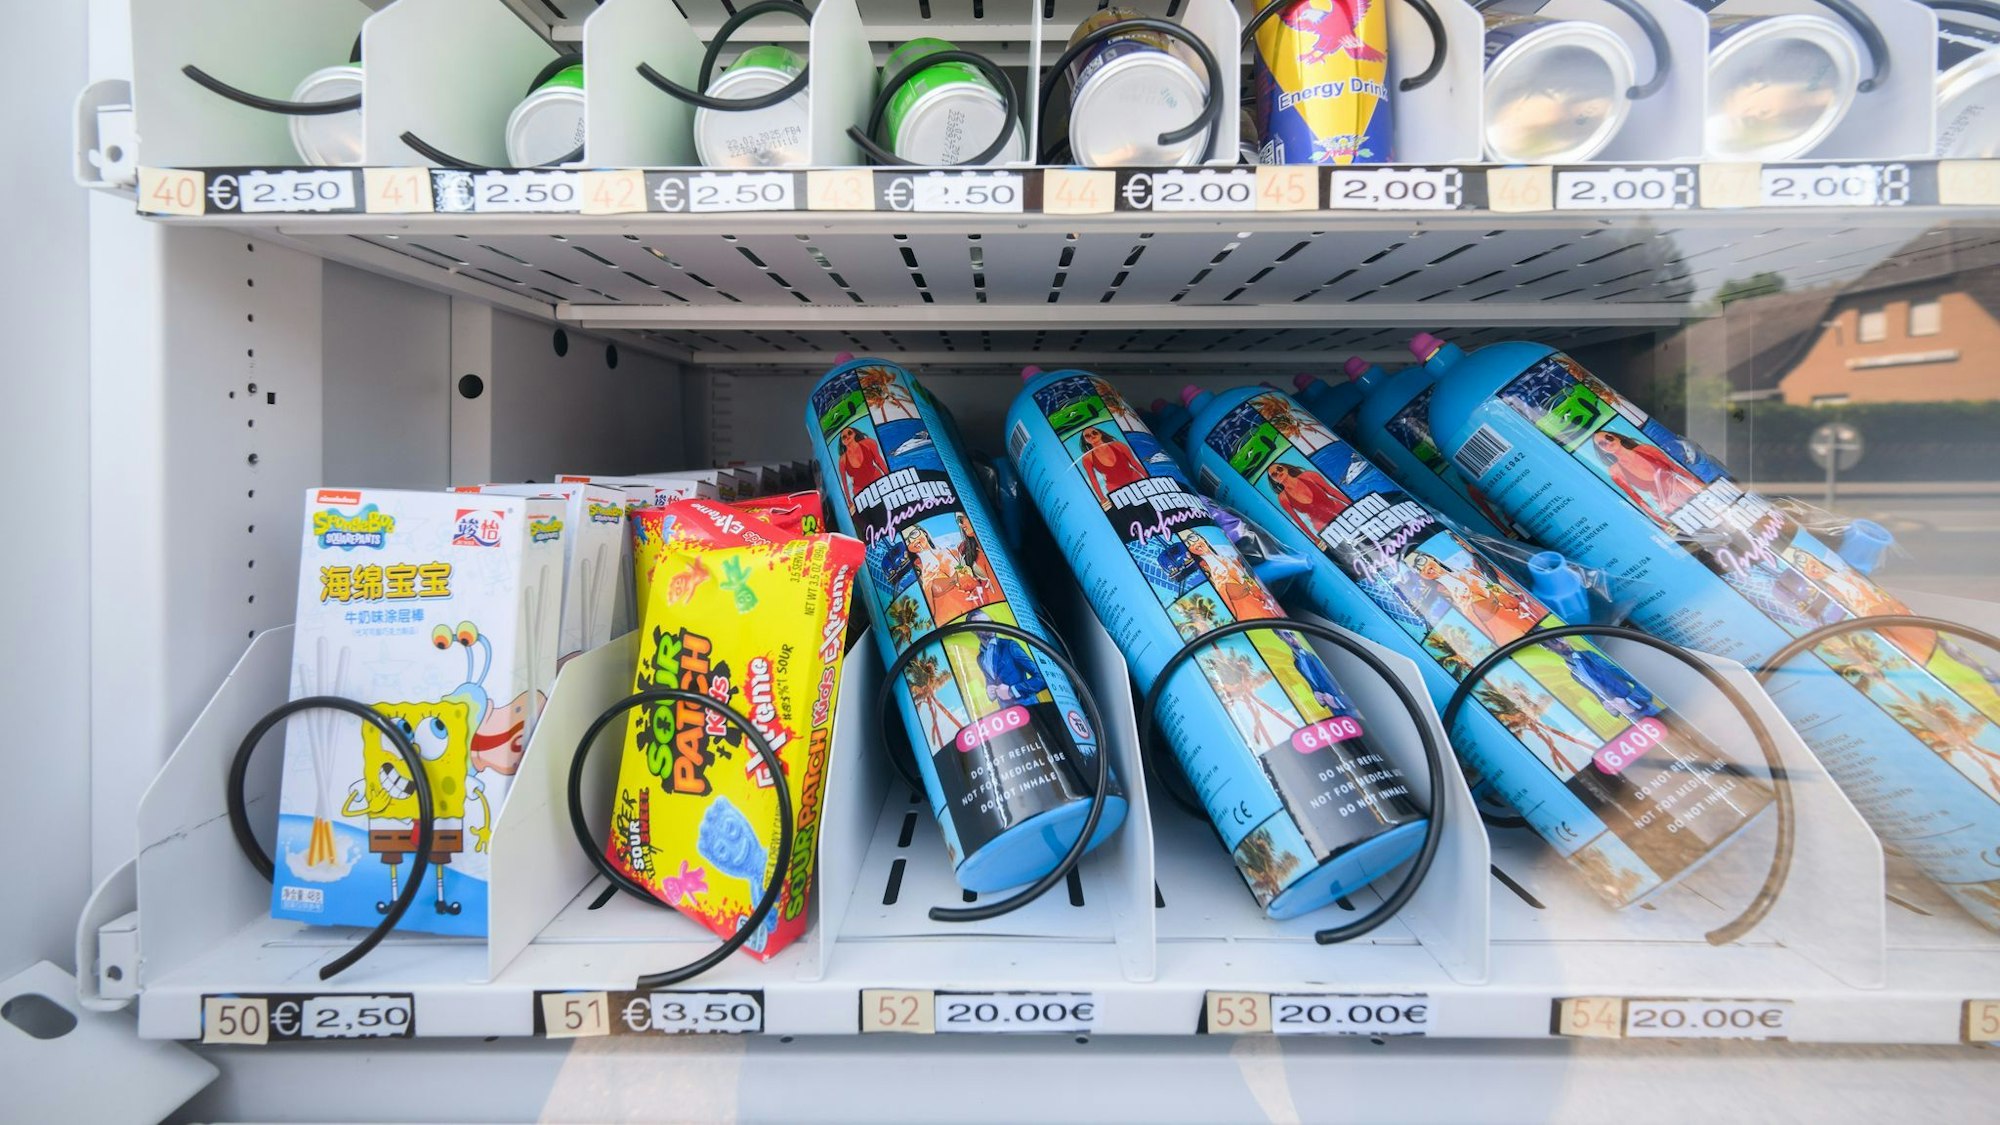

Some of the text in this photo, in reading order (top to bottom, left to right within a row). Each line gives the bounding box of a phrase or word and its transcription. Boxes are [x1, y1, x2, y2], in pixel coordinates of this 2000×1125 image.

[1278, 77, 1389, 111] Energy Drink
[152, 176, 197, 208] 40
[207, 175, 341, 210] € 2.50
[381, 175, 420, 205] 41
[485, 183, 574, 203] 2.50
[593, 178, 634, 208] 42
[654, 178, 785, 211] € 2.50
[822, 175, 863, 206] 43
[884, 178, 914, 211] €
[1054, 177, 1098, 208] 44
[1121, 173, 1250, 209] € 2.00
[1263, 174, 1306, 203] 45
[1343, 179, 1436, 203] 2,00
[1570, 180, 1664, 203] 2,00
[1503, 449, 1527, 472] E942
[866, 495, 956, 549] Infusions
[320, 561, 453, 603] 海绵宝宝
[777, 643, 794, 675] SOUR
[648, 633, 683, 780] SOUR
[812, 667, 834, 727] Kids
[673, 632, 712, 795] PATCH
[962, 709, 1021, 747] 640G
[1300, 719, 1357, 748] 640G
[1602, 723, 1662, 768] 640G
[970, 766, 984, 780] DO
[1007, 741, 1042, 763] REFILL
[1318, 770, 1335, 783] DO
[1357, 753, 1384, 768] REFILL
[797, 728, 828, 830] PATCH
[962, 790, 980, 806] NOT
[1001, 759, 1046, 782] MEDICAL
[1046, 751, 1066, 765] USE
[980, 799, 994, 813] DO
[1019, 771, 1057, 794] INHALE
[1634, 785, 1652, 801] DO
[1650, 770, 1673, 791] NOT
[1310, 794, 1332, 810] NOT
[1334, 781, 1355, 798] FOR
[1339, 802, 1355, 817] DO
[1378, 784, 1408, 802] INHALE
[1633, 812, 1657, 830] NOT
[1656, 796, 1676, 814] FOR
[1666, 817, 1683, 834] DO
[1683, 801, 1706, 823] NOT
[629, 819, 645, 872] SOUR
[785, 825, 814, 921] SOUR
[217, 1004, 261, 1037] 50
[270, 1002, 409, 1034] € 2,50
[564, 1001, 601, 1031] 51
[621, 998, 757, 1032] € 3,50
[877, 996, 920, 1027] 52
[946, 1002, 1095, 1024] 20.00€
[1216, 997, 1259, 1027] 53
[1278, 1004, 1429, 1025] 20.00€
[1572, 1001, 1616, 1030] 54
[1633, 1008, 1783, 1029] 20.00€
[1982, 1004, 2000, 1035] 5
